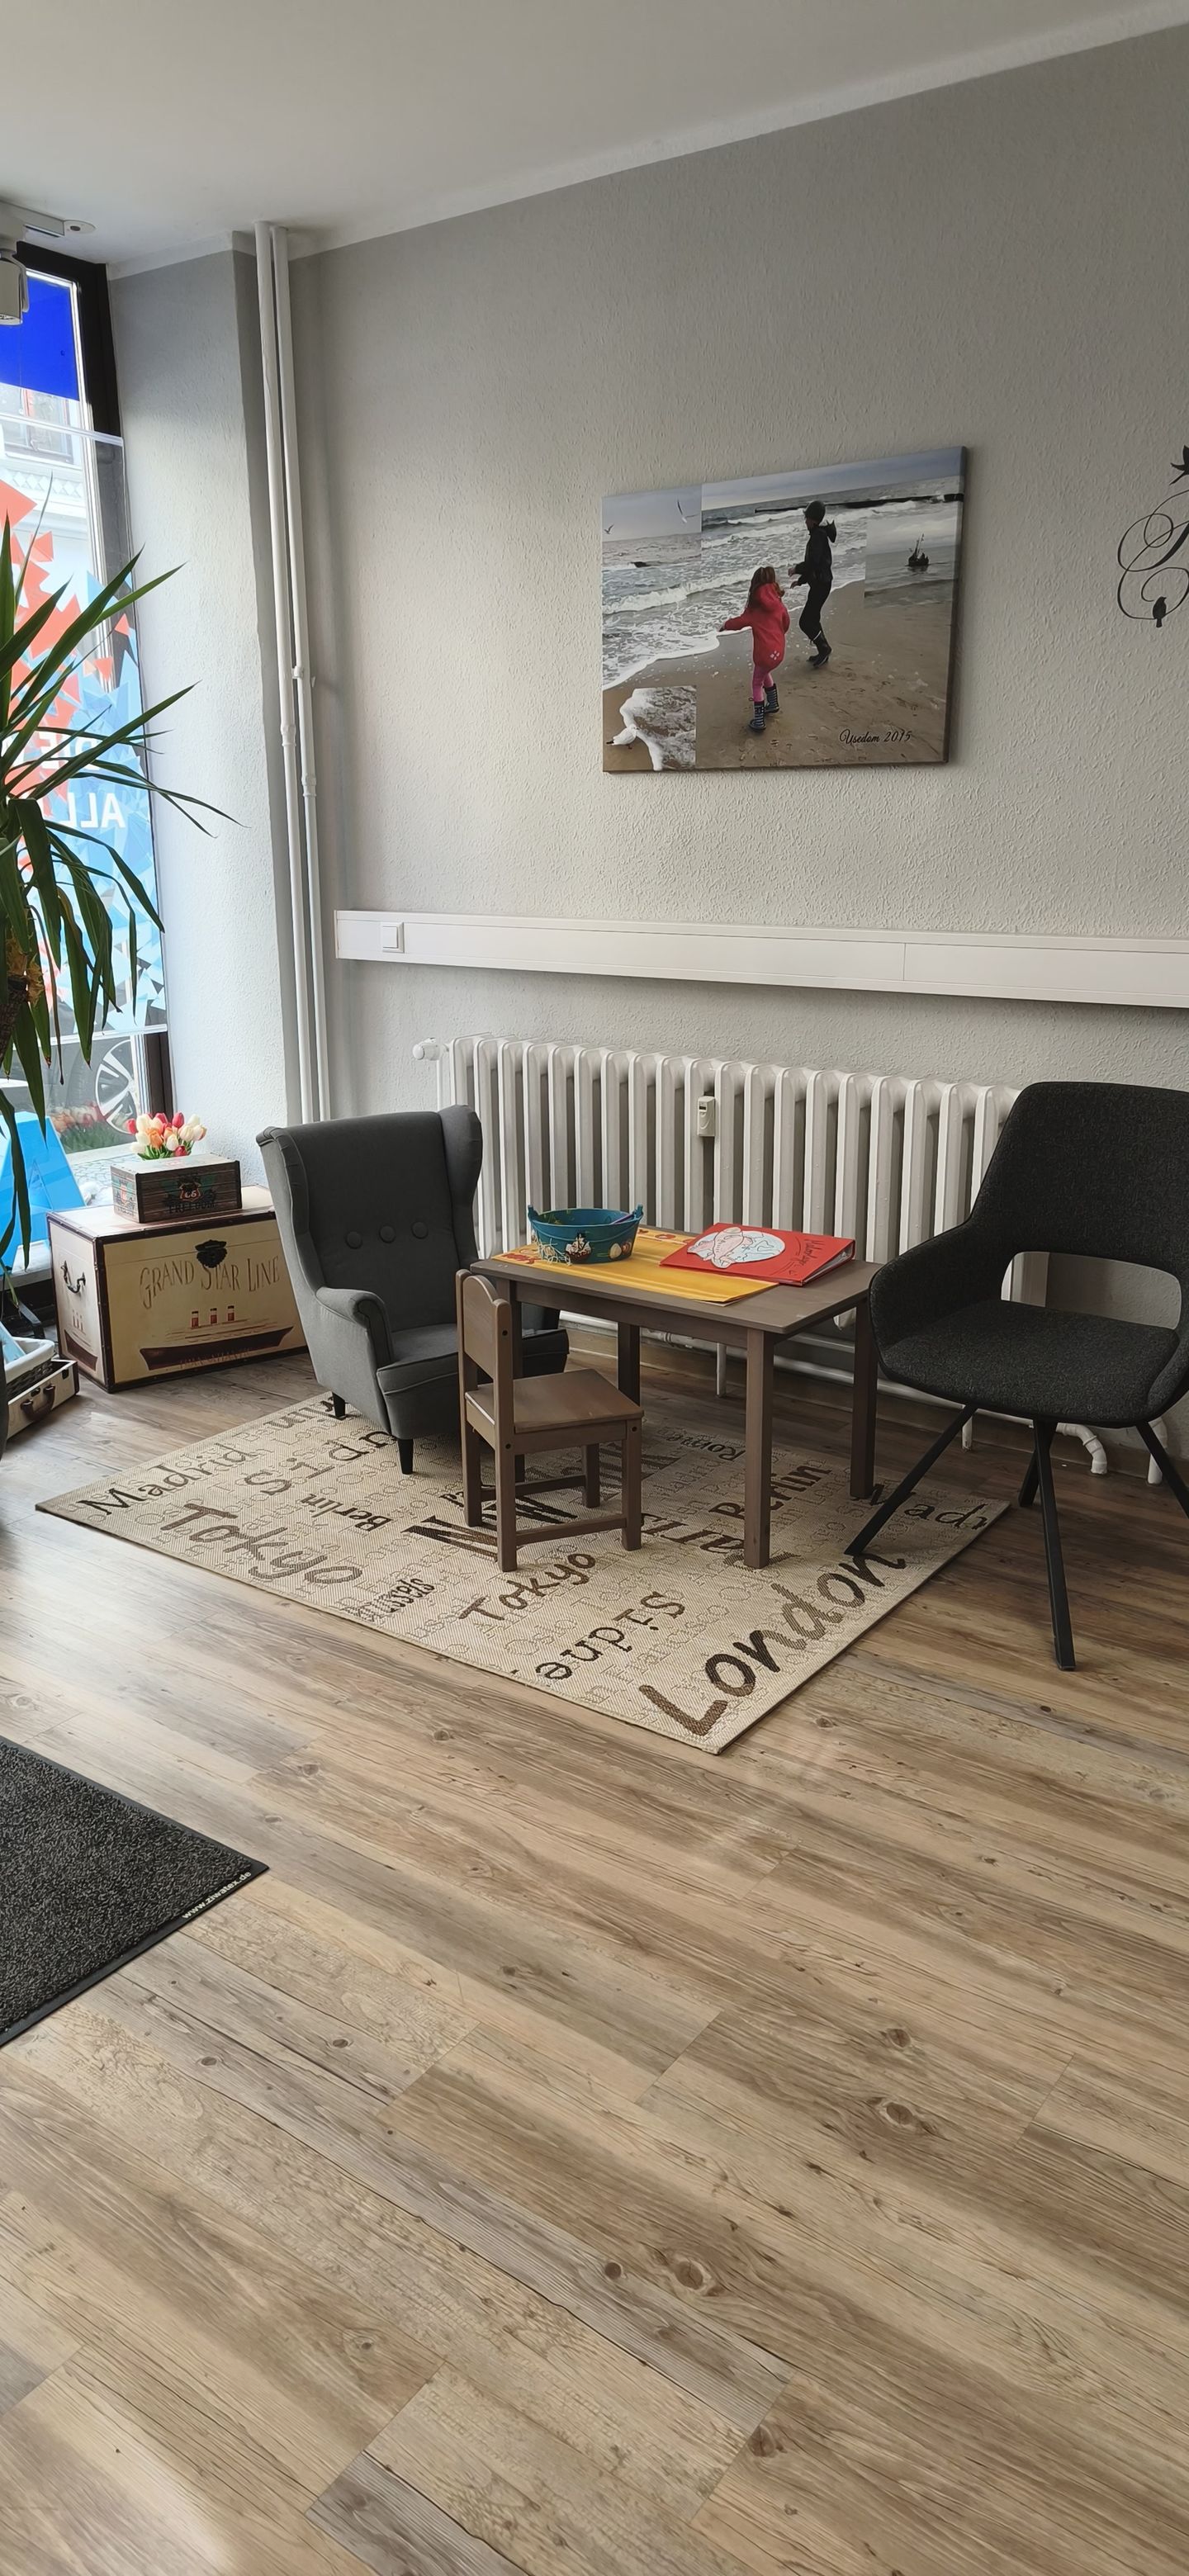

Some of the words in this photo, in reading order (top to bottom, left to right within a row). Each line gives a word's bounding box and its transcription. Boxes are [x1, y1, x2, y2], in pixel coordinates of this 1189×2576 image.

[839, 728, 880, 745] Usedom
[140, 1260, 195, 1309] GRAND
[201, 1263, 240, 1291] STAR
[247, 1256, 281, 1292] LINE
[77, 1442, 249, 1515] Madrid
[299, 1493, 394, 1532] Berlin
[160, 1503, 363, 1584] Tokyo
[459, 1553, 596, 1621] Tokyo
[639, 1552, 907, 1736] London
[182, 1871, 252, 1920] www.ziwatex.de
